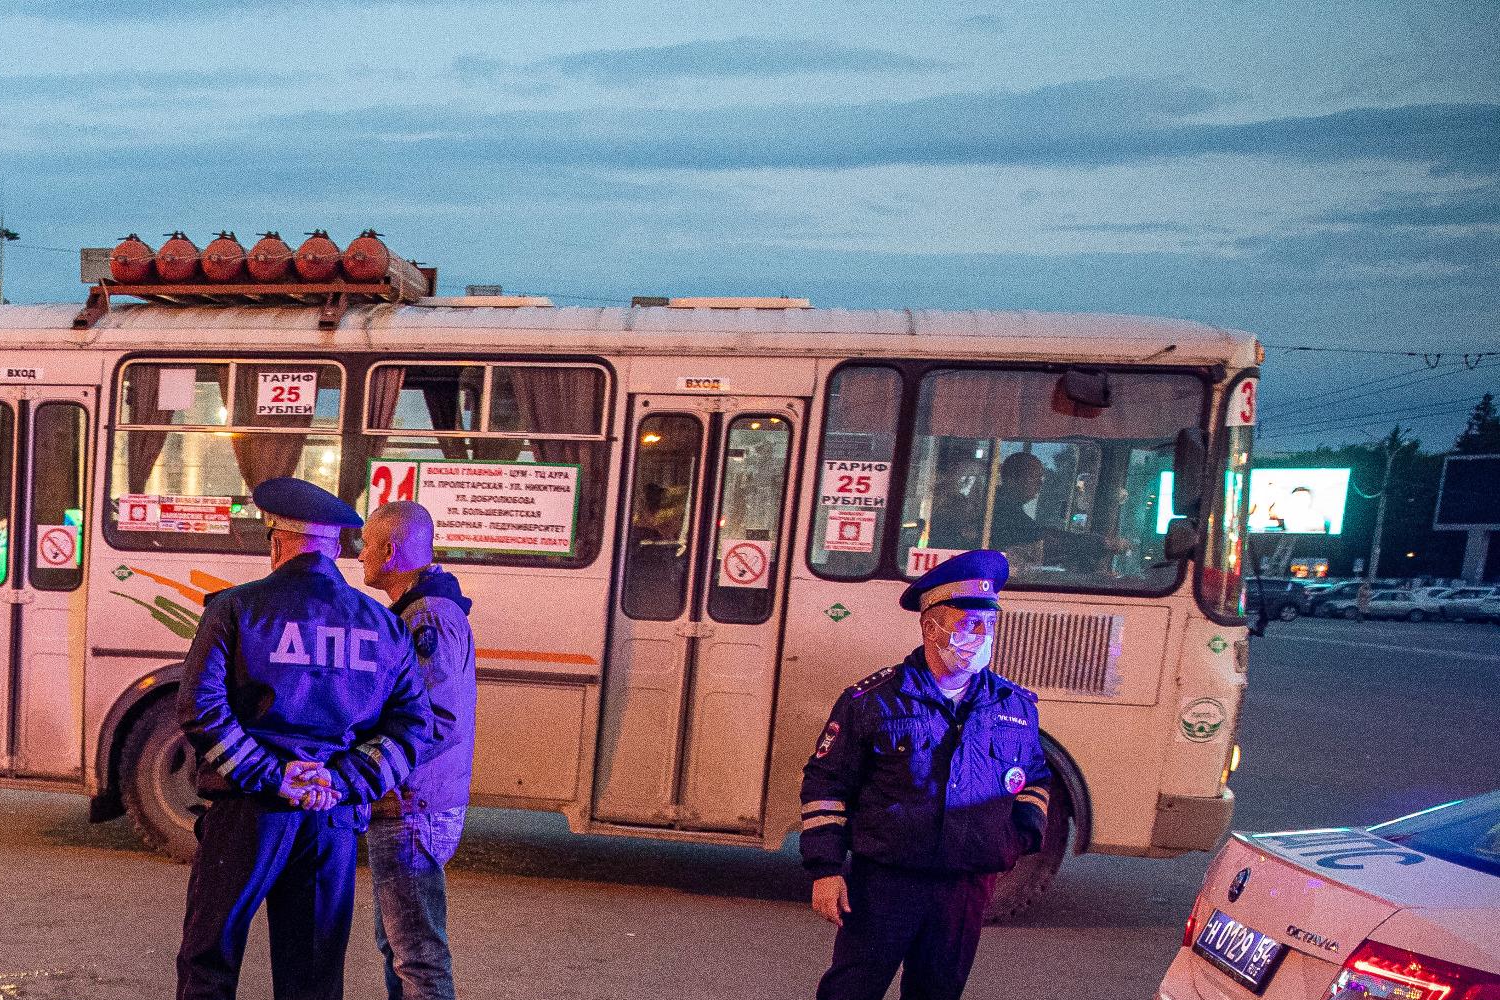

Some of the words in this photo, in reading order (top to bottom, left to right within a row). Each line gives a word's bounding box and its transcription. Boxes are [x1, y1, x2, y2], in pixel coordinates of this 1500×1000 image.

[6, 368, 36, 379] ВХОД
[260, 374, 314, 382] ТАРИФ
[685, 379, 720, 389] ВХОД
[271, 386, 301, 403] 25
[258, 404, 313, 414] РУБЛЕЙ
[826, 461, 888, 472] ТАРИФ
[427, 467, 460, 476] ВОКЗАЛ
[461, 467, 503, 477] ГЛАВНЫЙ
[534, 470, 546, 480] ТЦ
[547, 471, 570, 480] АУРА
[423, 480, 436, 488] УЛ.
[438, 480, 503, 491] ПРОЛЕТАРСКАЯ
[510, 483, 523, 491] УЛ.
[524, 484, 571, 493] НИКИТИНА
[837, 475, 871, 494] 25
[456, 494, 468, 502] УЛ.
[470, 495, 535, 505] ДОБРОЛЮБОВА
[821, 495, 885, 507] РУБЛЕЙ
[462, 508, 542, 519] БОЛЬШЕВИСТСКАЯ
[436, 520, 483, 530] ВЫБОРНАЯ
[489, 521, 566, 533] ПЕДУНИВЕРСИТЕТ
[539, 537, 569, 547] ПЛАТО
[269, 621, 379, 673] ДПС
[1286, 925, 1340, 953] OCTAVIA
